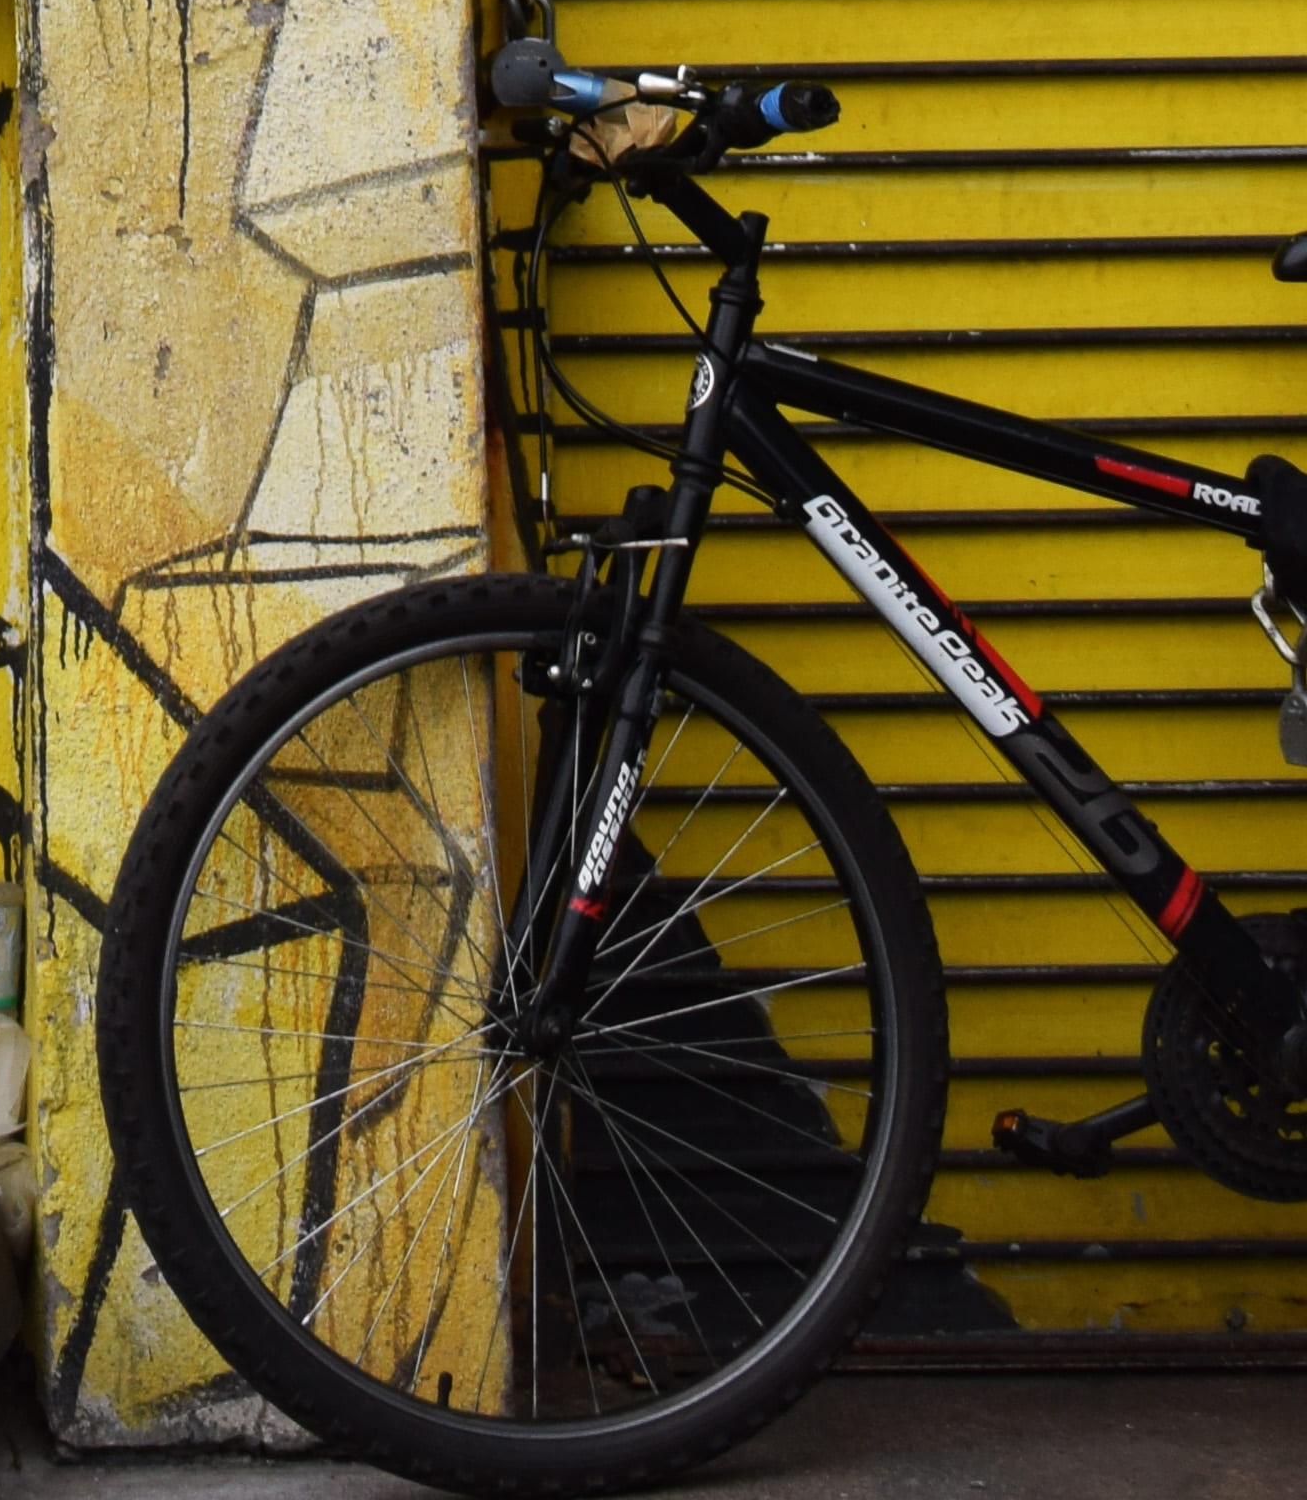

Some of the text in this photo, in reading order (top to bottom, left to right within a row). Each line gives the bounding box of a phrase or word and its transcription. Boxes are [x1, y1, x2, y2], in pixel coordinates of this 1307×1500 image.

[802, 494, 1032, 730] Granite Peak
[578, 761, 630, 894] ground
[1001, 719, 1161, 877] 26
